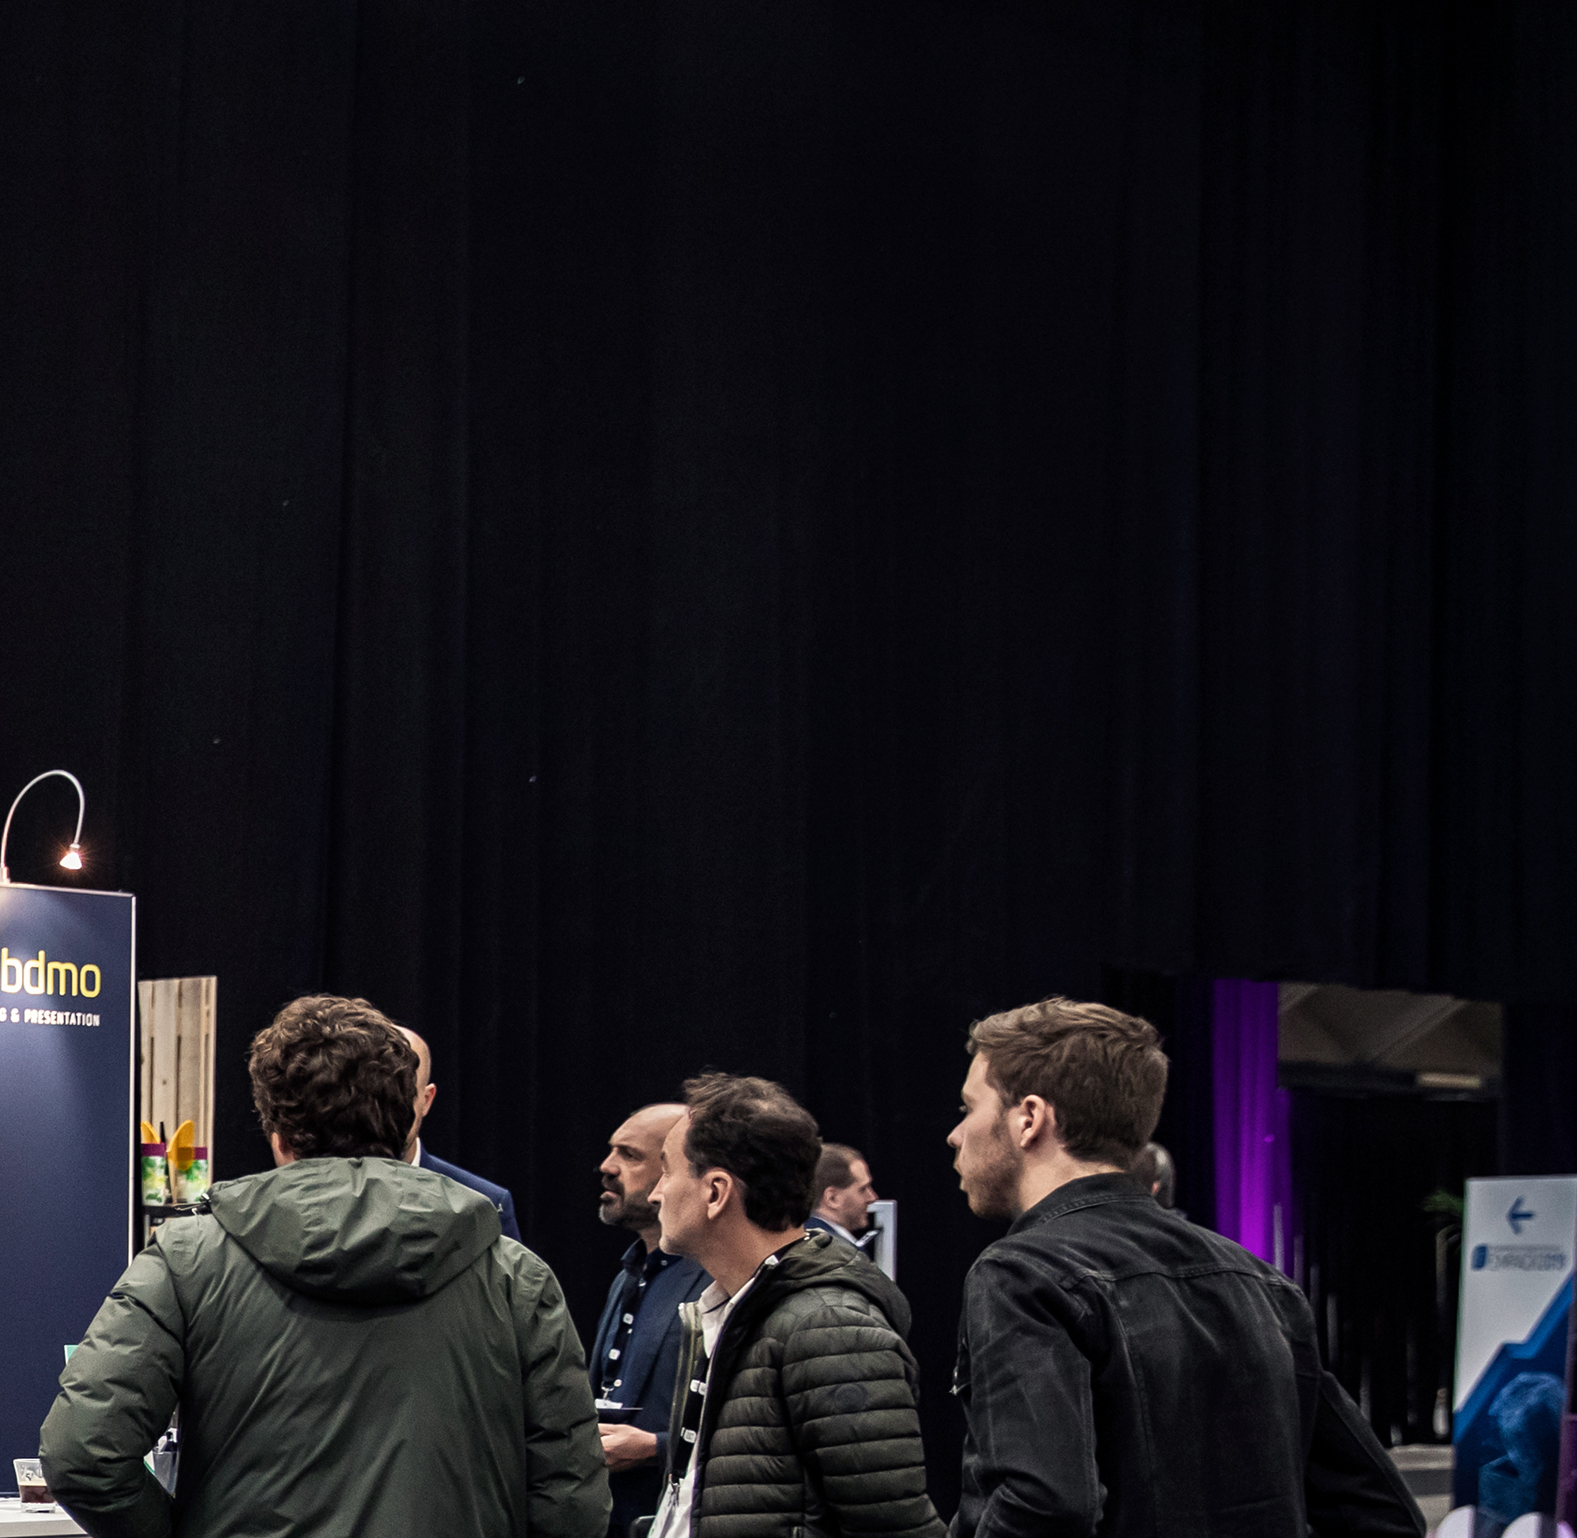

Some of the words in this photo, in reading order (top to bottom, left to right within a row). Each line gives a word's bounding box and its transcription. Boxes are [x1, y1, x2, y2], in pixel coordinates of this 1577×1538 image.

[0, 947, 102, 998] bdmo
[10, 1008, 20, 1023] &
[23, 1008, 101, 1027] PRESENTATION
